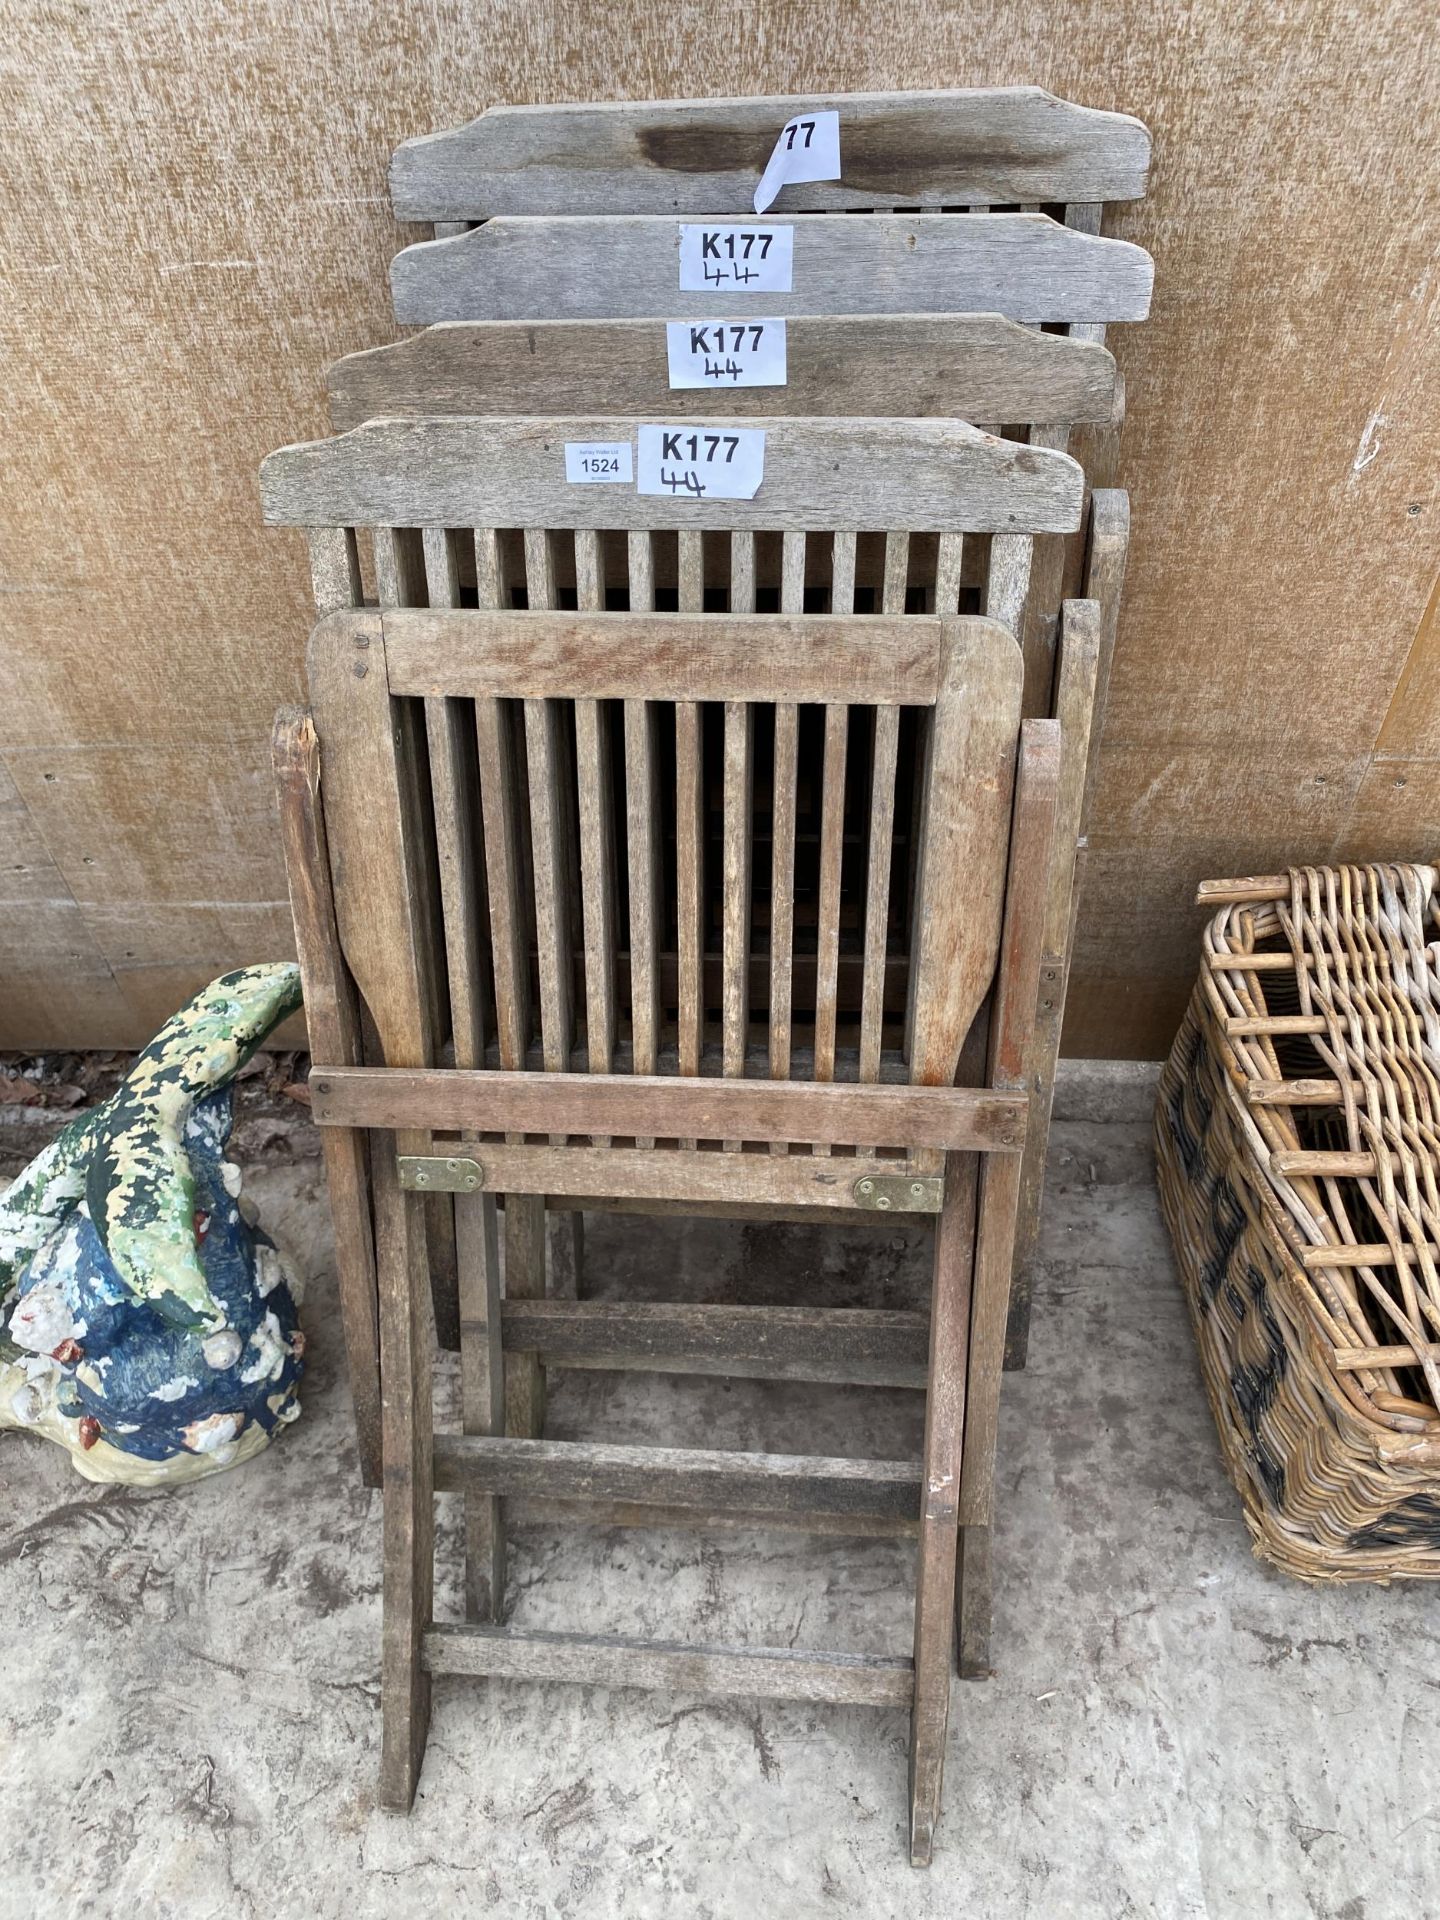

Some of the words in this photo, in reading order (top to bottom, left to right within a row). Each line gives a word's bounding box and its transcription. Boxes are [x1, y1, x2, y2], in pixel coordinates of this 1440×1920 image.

[702, 232, 773, 259] K177
[703, 261, 759, 287] 44
[690, 325, 764, 353] K177
[704, 357, 743, 381] 44
[662, 432, 740, 463] K177
[581, 458, 620, 472] 1524
[660, 466, 706, 497] 44
